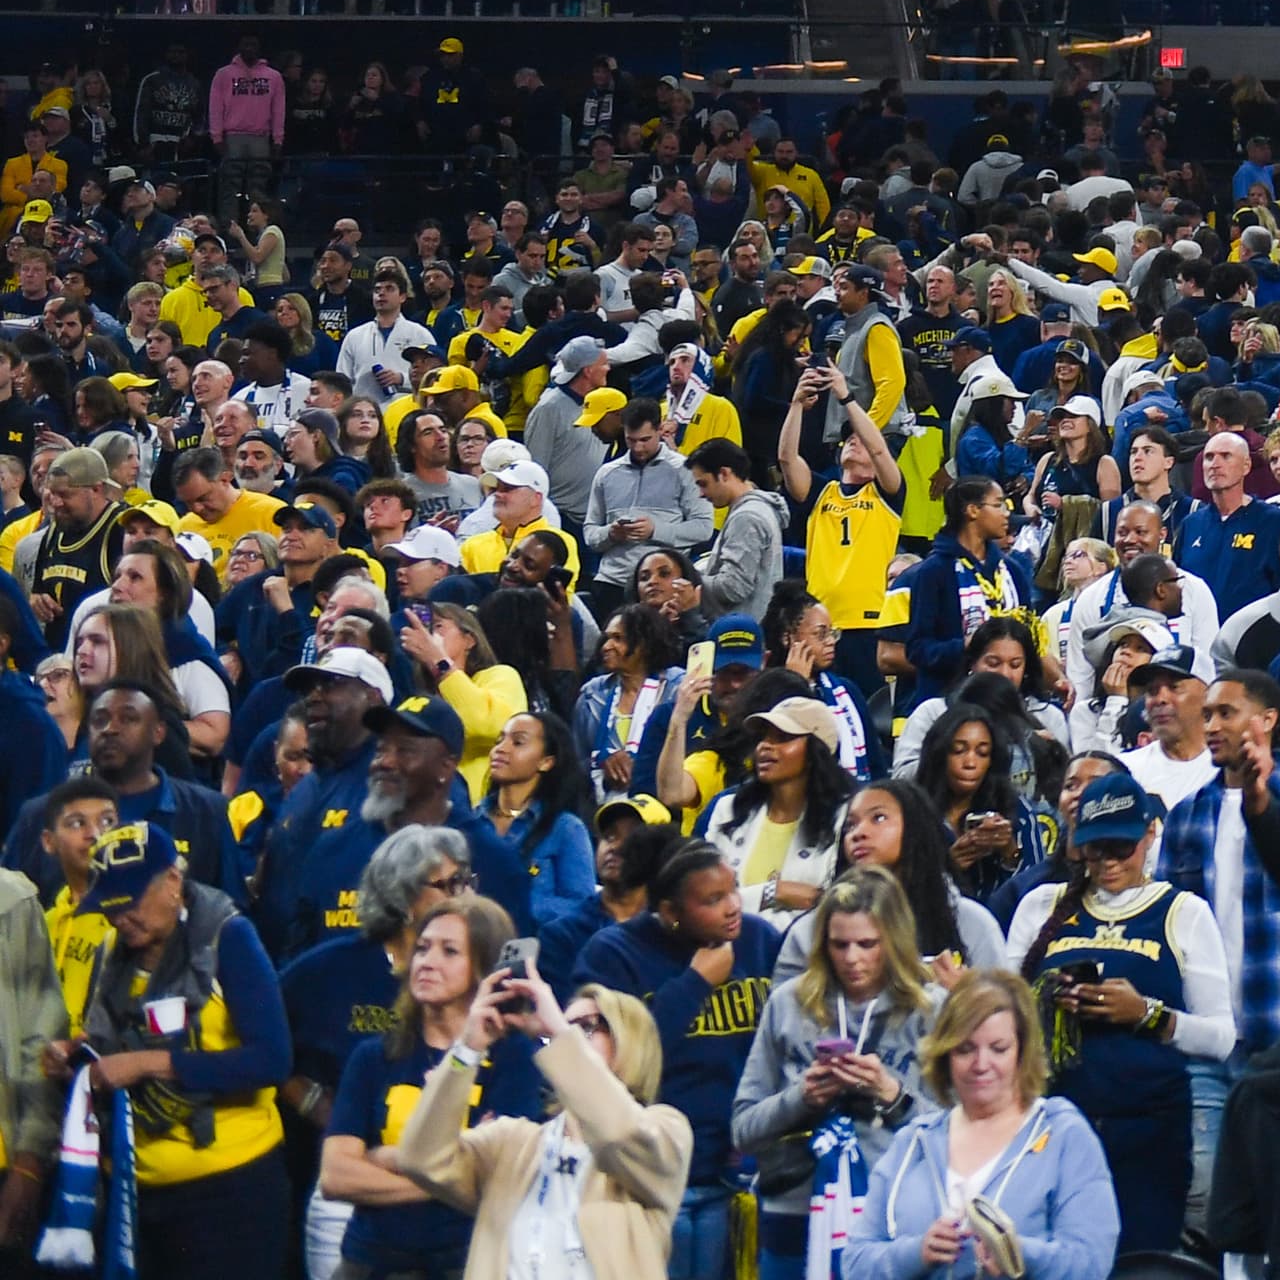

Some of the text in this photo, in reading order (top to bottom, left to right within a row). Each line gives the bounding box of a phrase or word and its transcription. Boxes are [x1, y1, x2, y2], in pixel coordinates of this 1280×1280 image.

[1160, 48, 1183, 67] EXIT
[912, 329, 960, 348] MICHIGA
[8, 431, 25, 444] M
[840, 516, 851, 547] 1
[1230, 533, 1255, 551] M
[1080, 792, 1134, 822] Michigan
[320, 808, 349, 829] M
